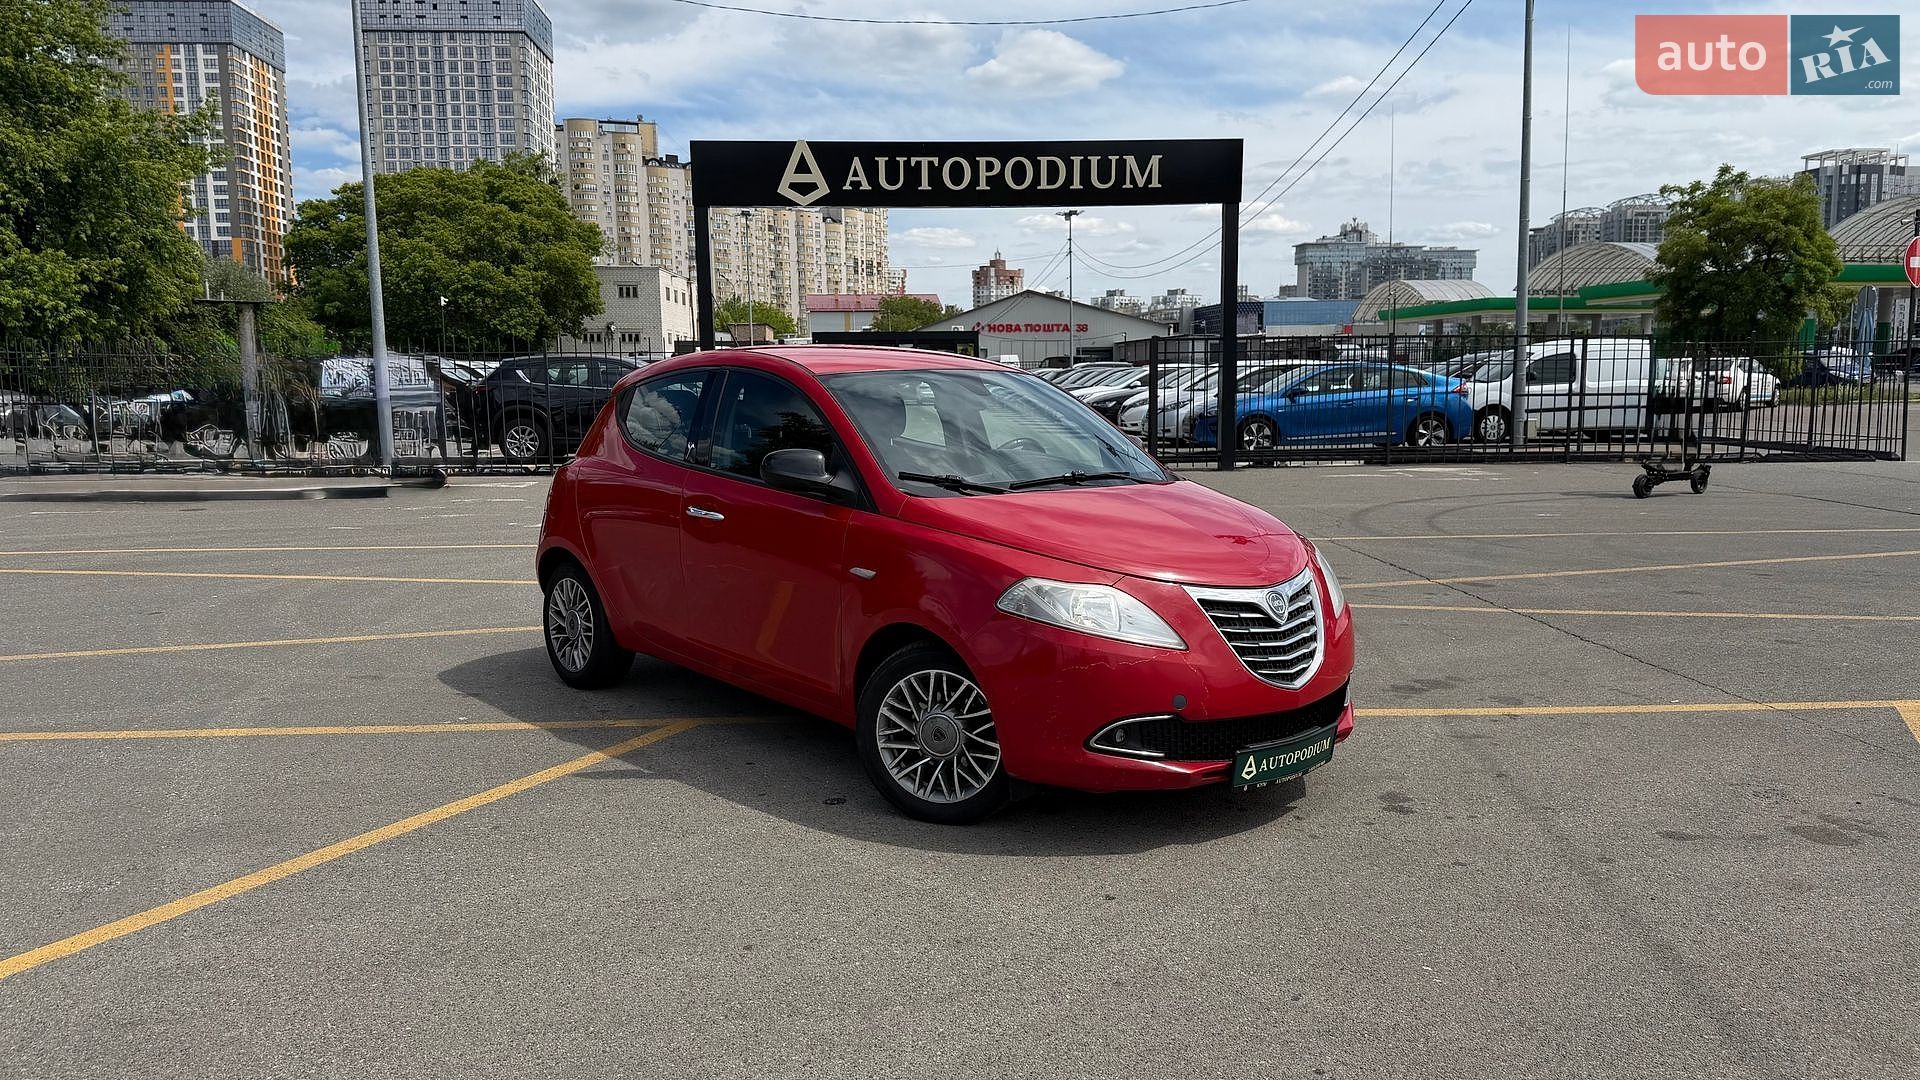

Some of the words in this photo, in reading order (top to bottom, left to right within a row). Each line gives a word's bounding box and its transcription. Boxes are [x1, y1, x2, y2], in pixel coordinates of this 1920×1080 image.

[842, 154, 1163, 191] AUTOPODIUM
[987, 323, 1022, 333] НОВА
[1024, 323, 1070, 333] ПОШТА
[1076, 323, 1089, 333] 38
[1259, 736, 1331, 772] AUTOPODIUM
